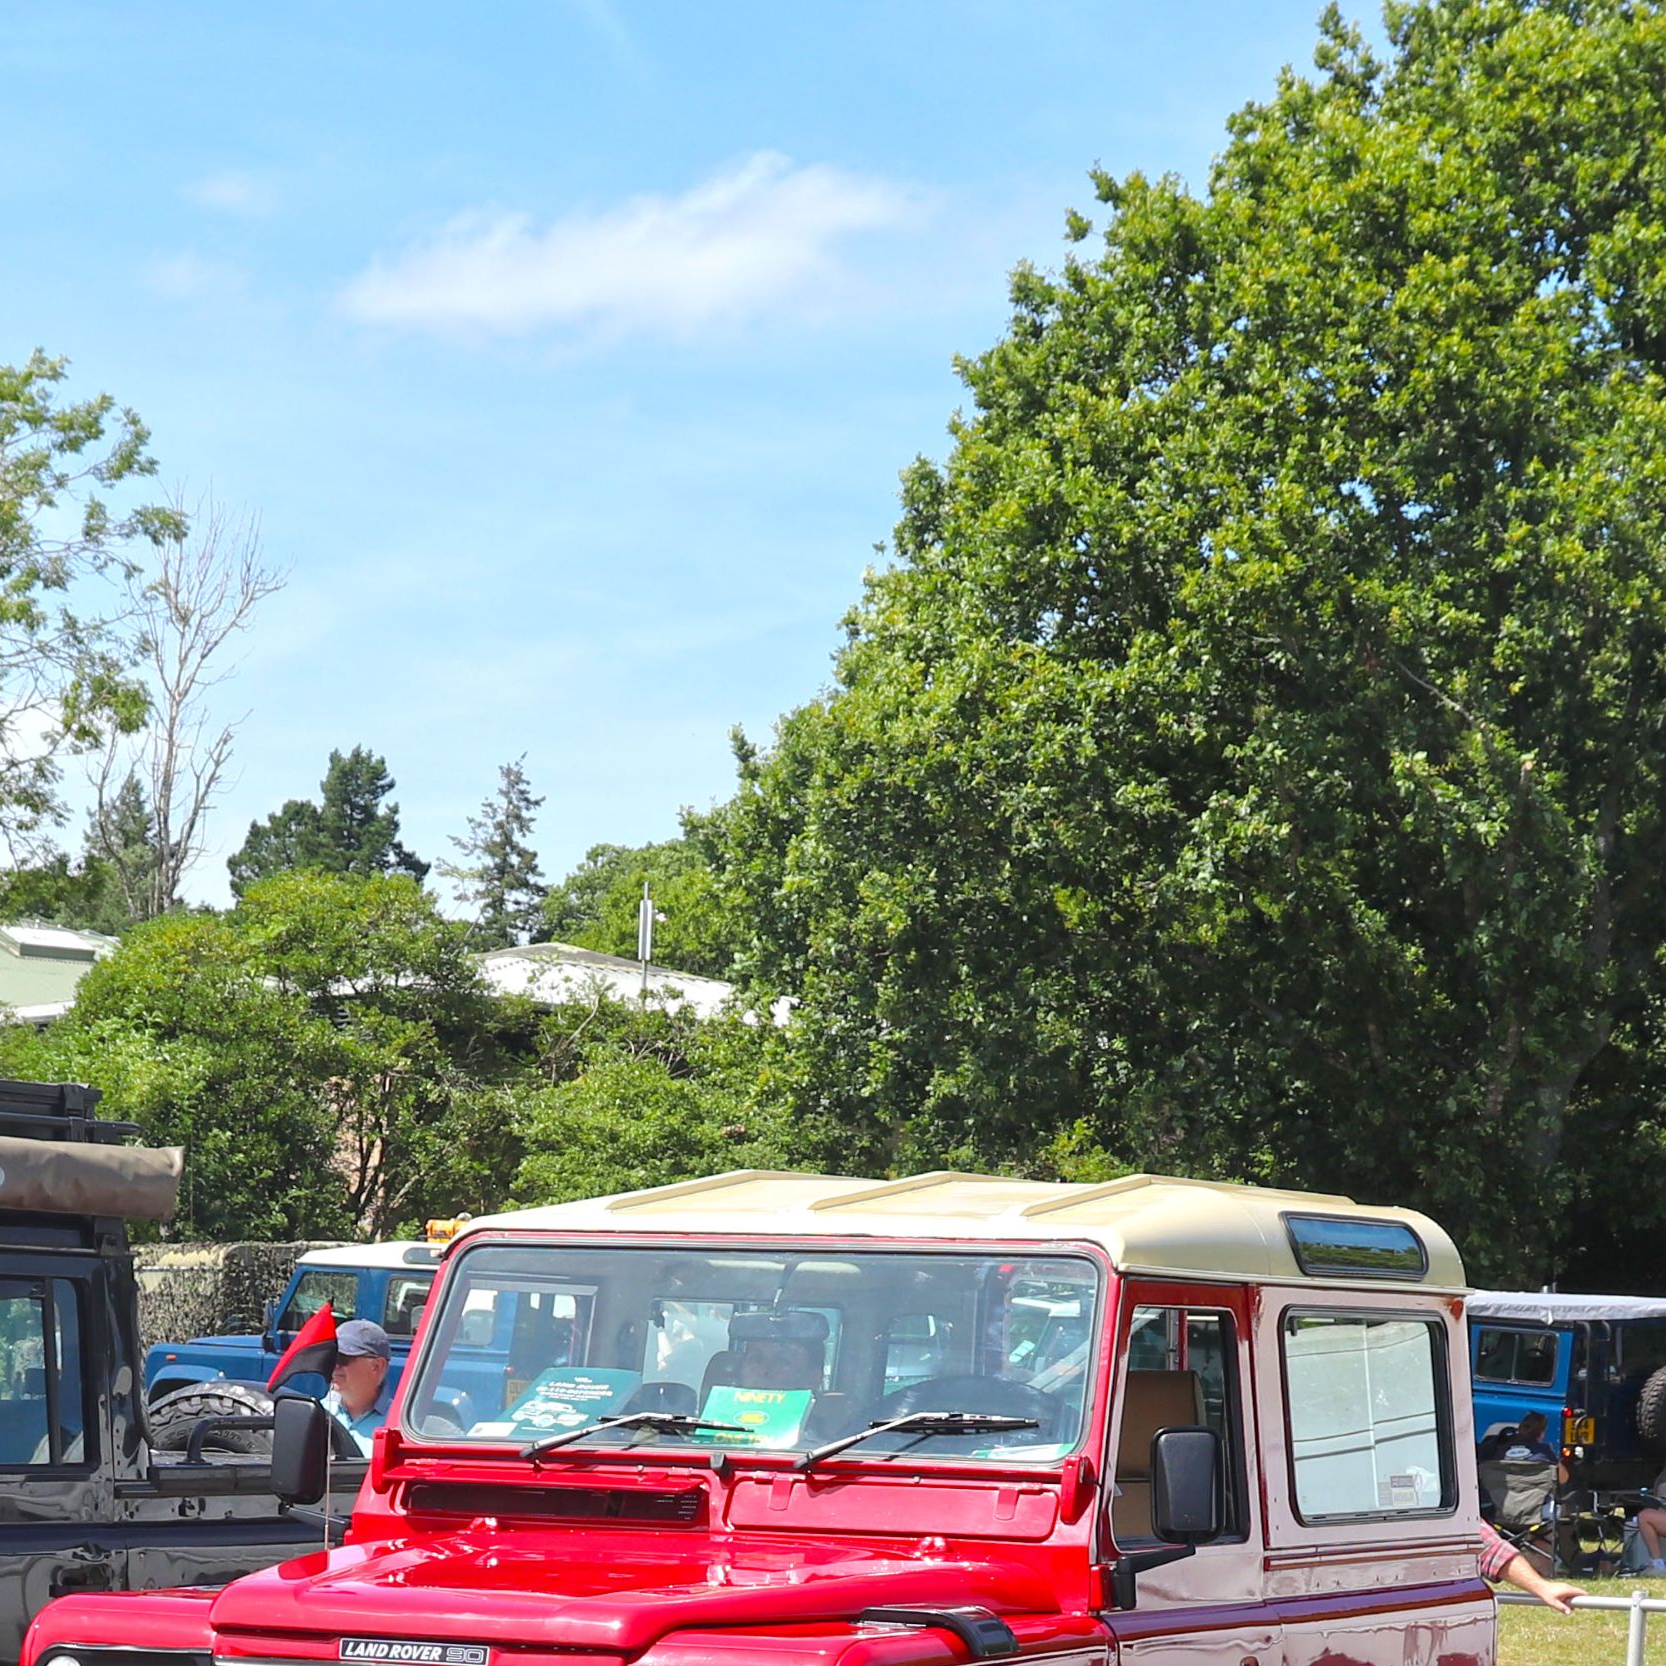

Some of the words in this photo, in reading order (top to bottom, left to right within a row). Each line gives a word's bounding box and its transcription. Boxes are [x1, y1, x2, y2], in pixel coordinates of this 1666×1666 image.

[734, 1391, 786, 1404] NINETY
[345, 1641, 388, 1657] LAND
[388, 1645, 442, 1661] ROVER
[446, 1647, 484, 1663] 90
